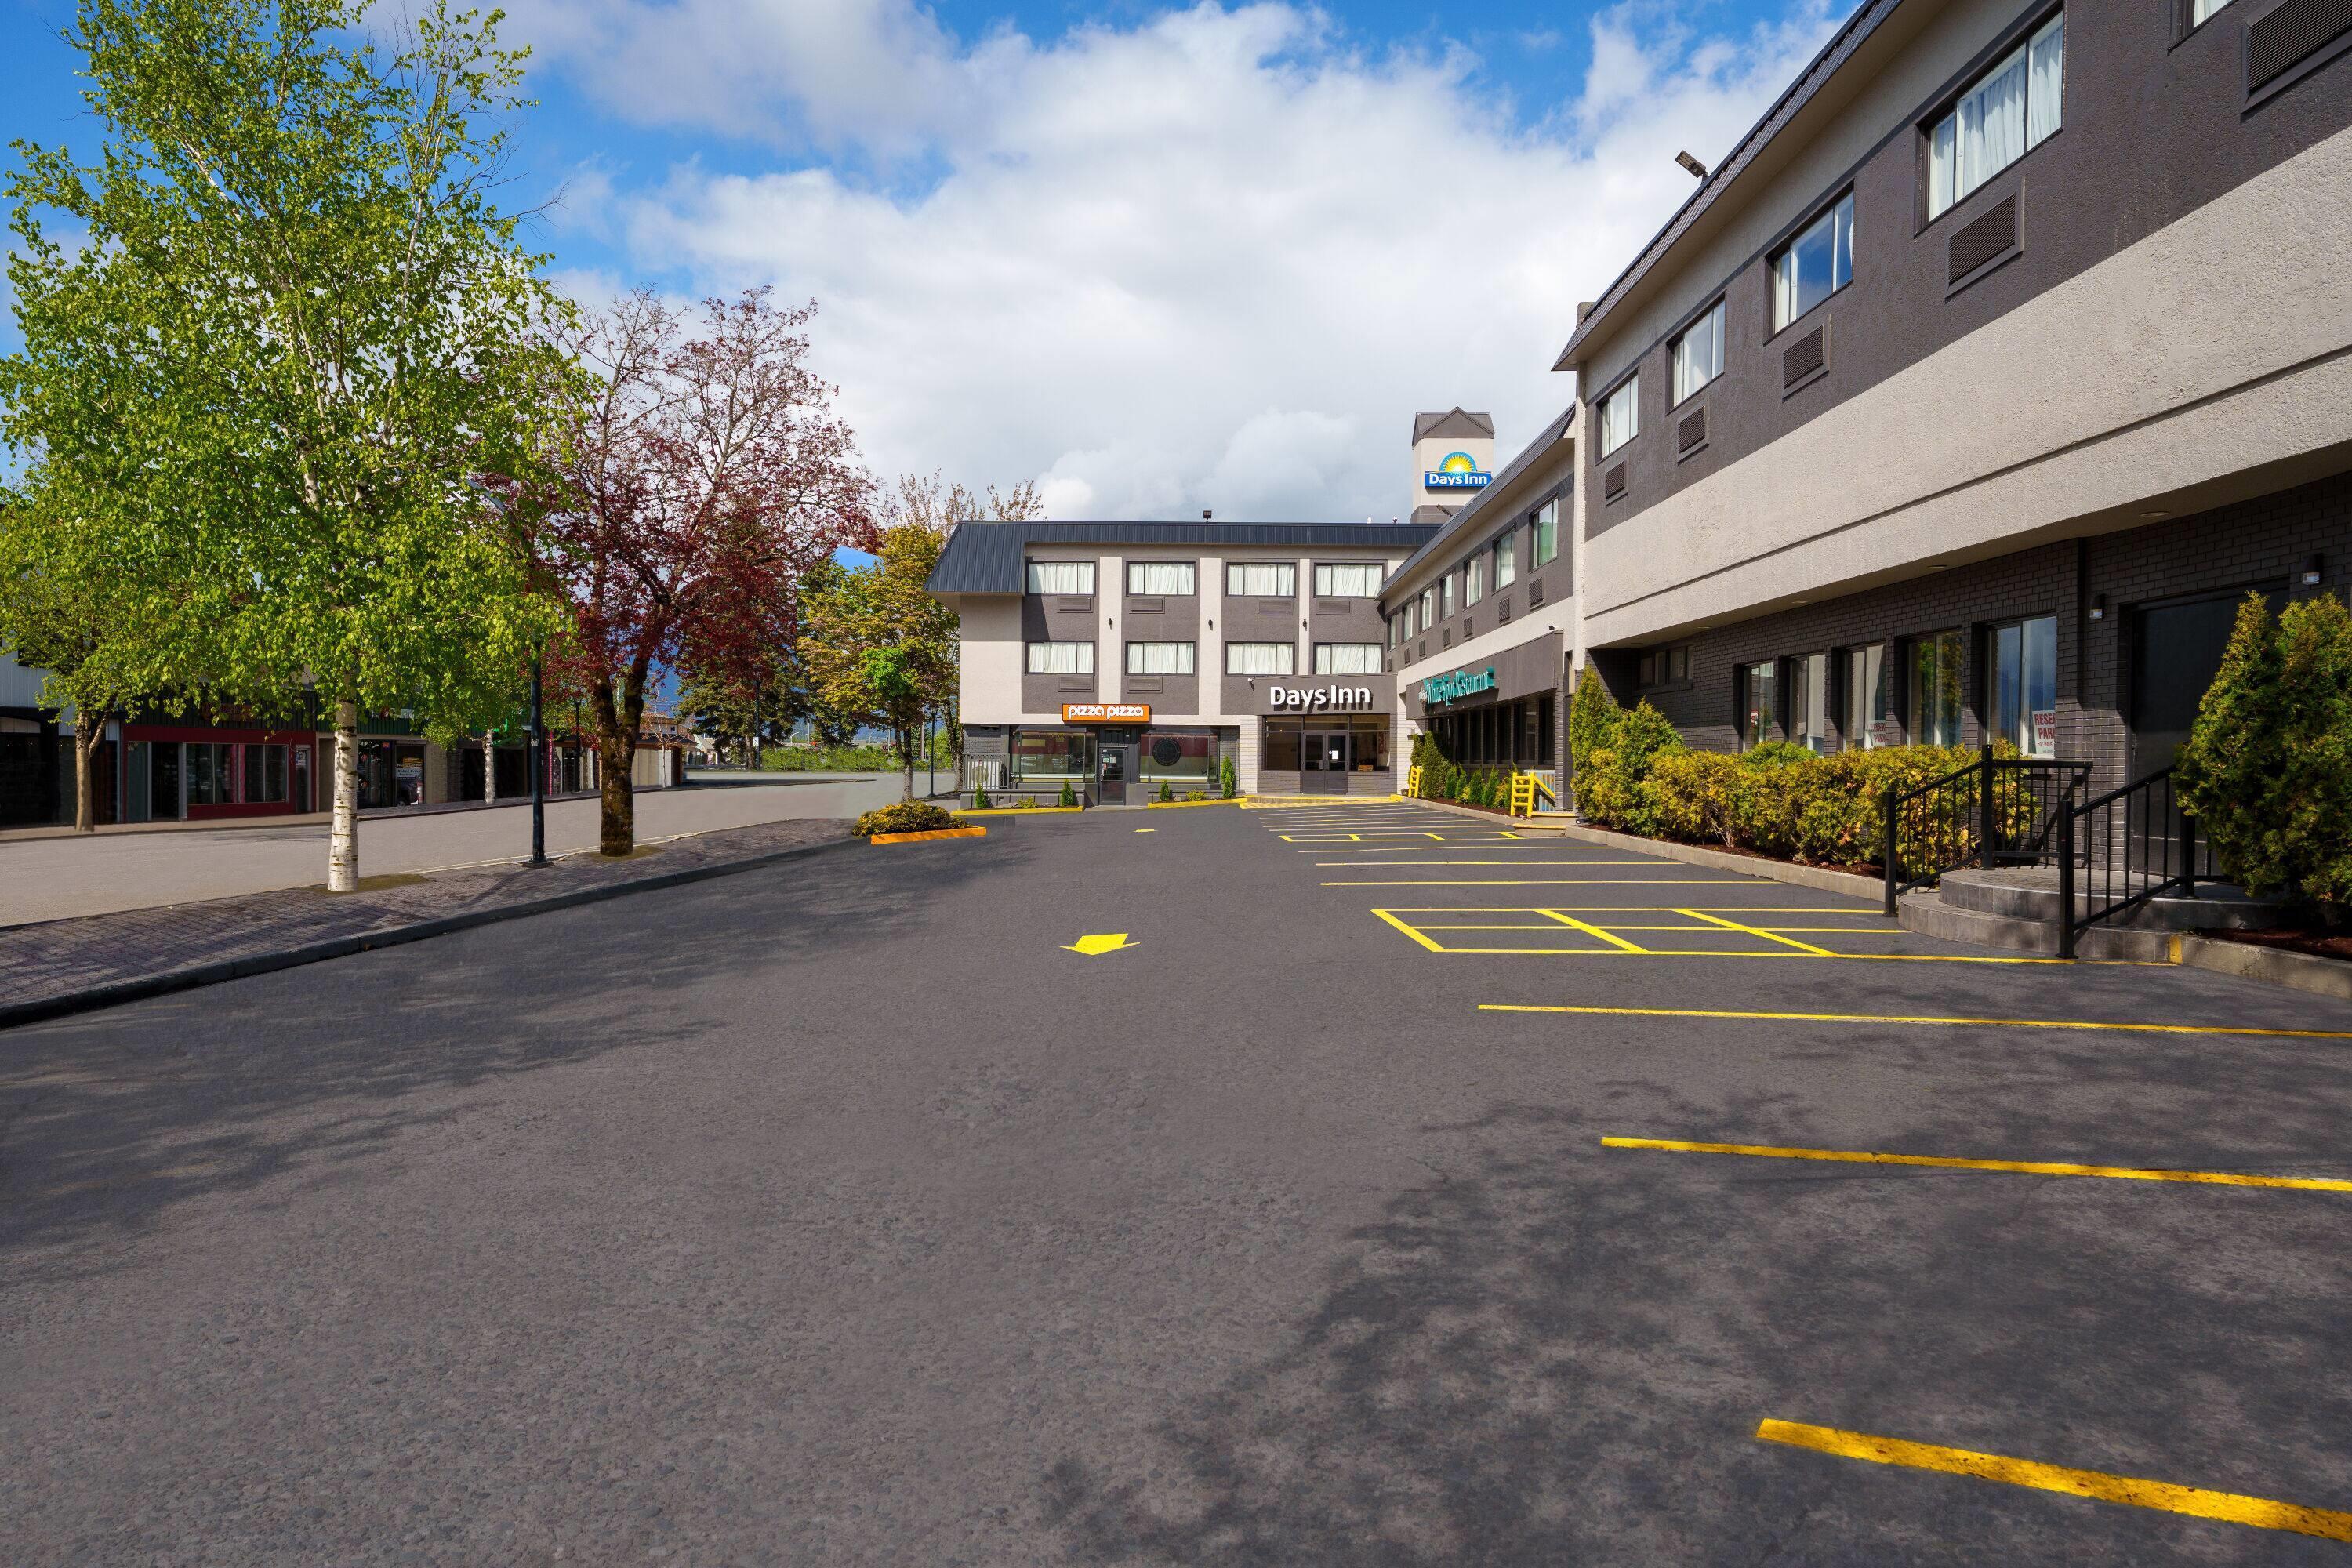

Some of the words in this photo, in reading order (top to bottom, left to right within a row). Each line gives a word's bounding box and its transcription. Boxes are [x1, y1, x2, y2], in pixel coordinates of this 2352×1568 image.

[1429, 474, 1463, 485] Days
[1465, 474, 1487, 485] Inn
[1270, 686, 1327, 707] Days
[1330, 684, 1370, 704] Inn
[1068, 706, 1105, 720] pizza
[1106, 706, 1144, 720] pizza
